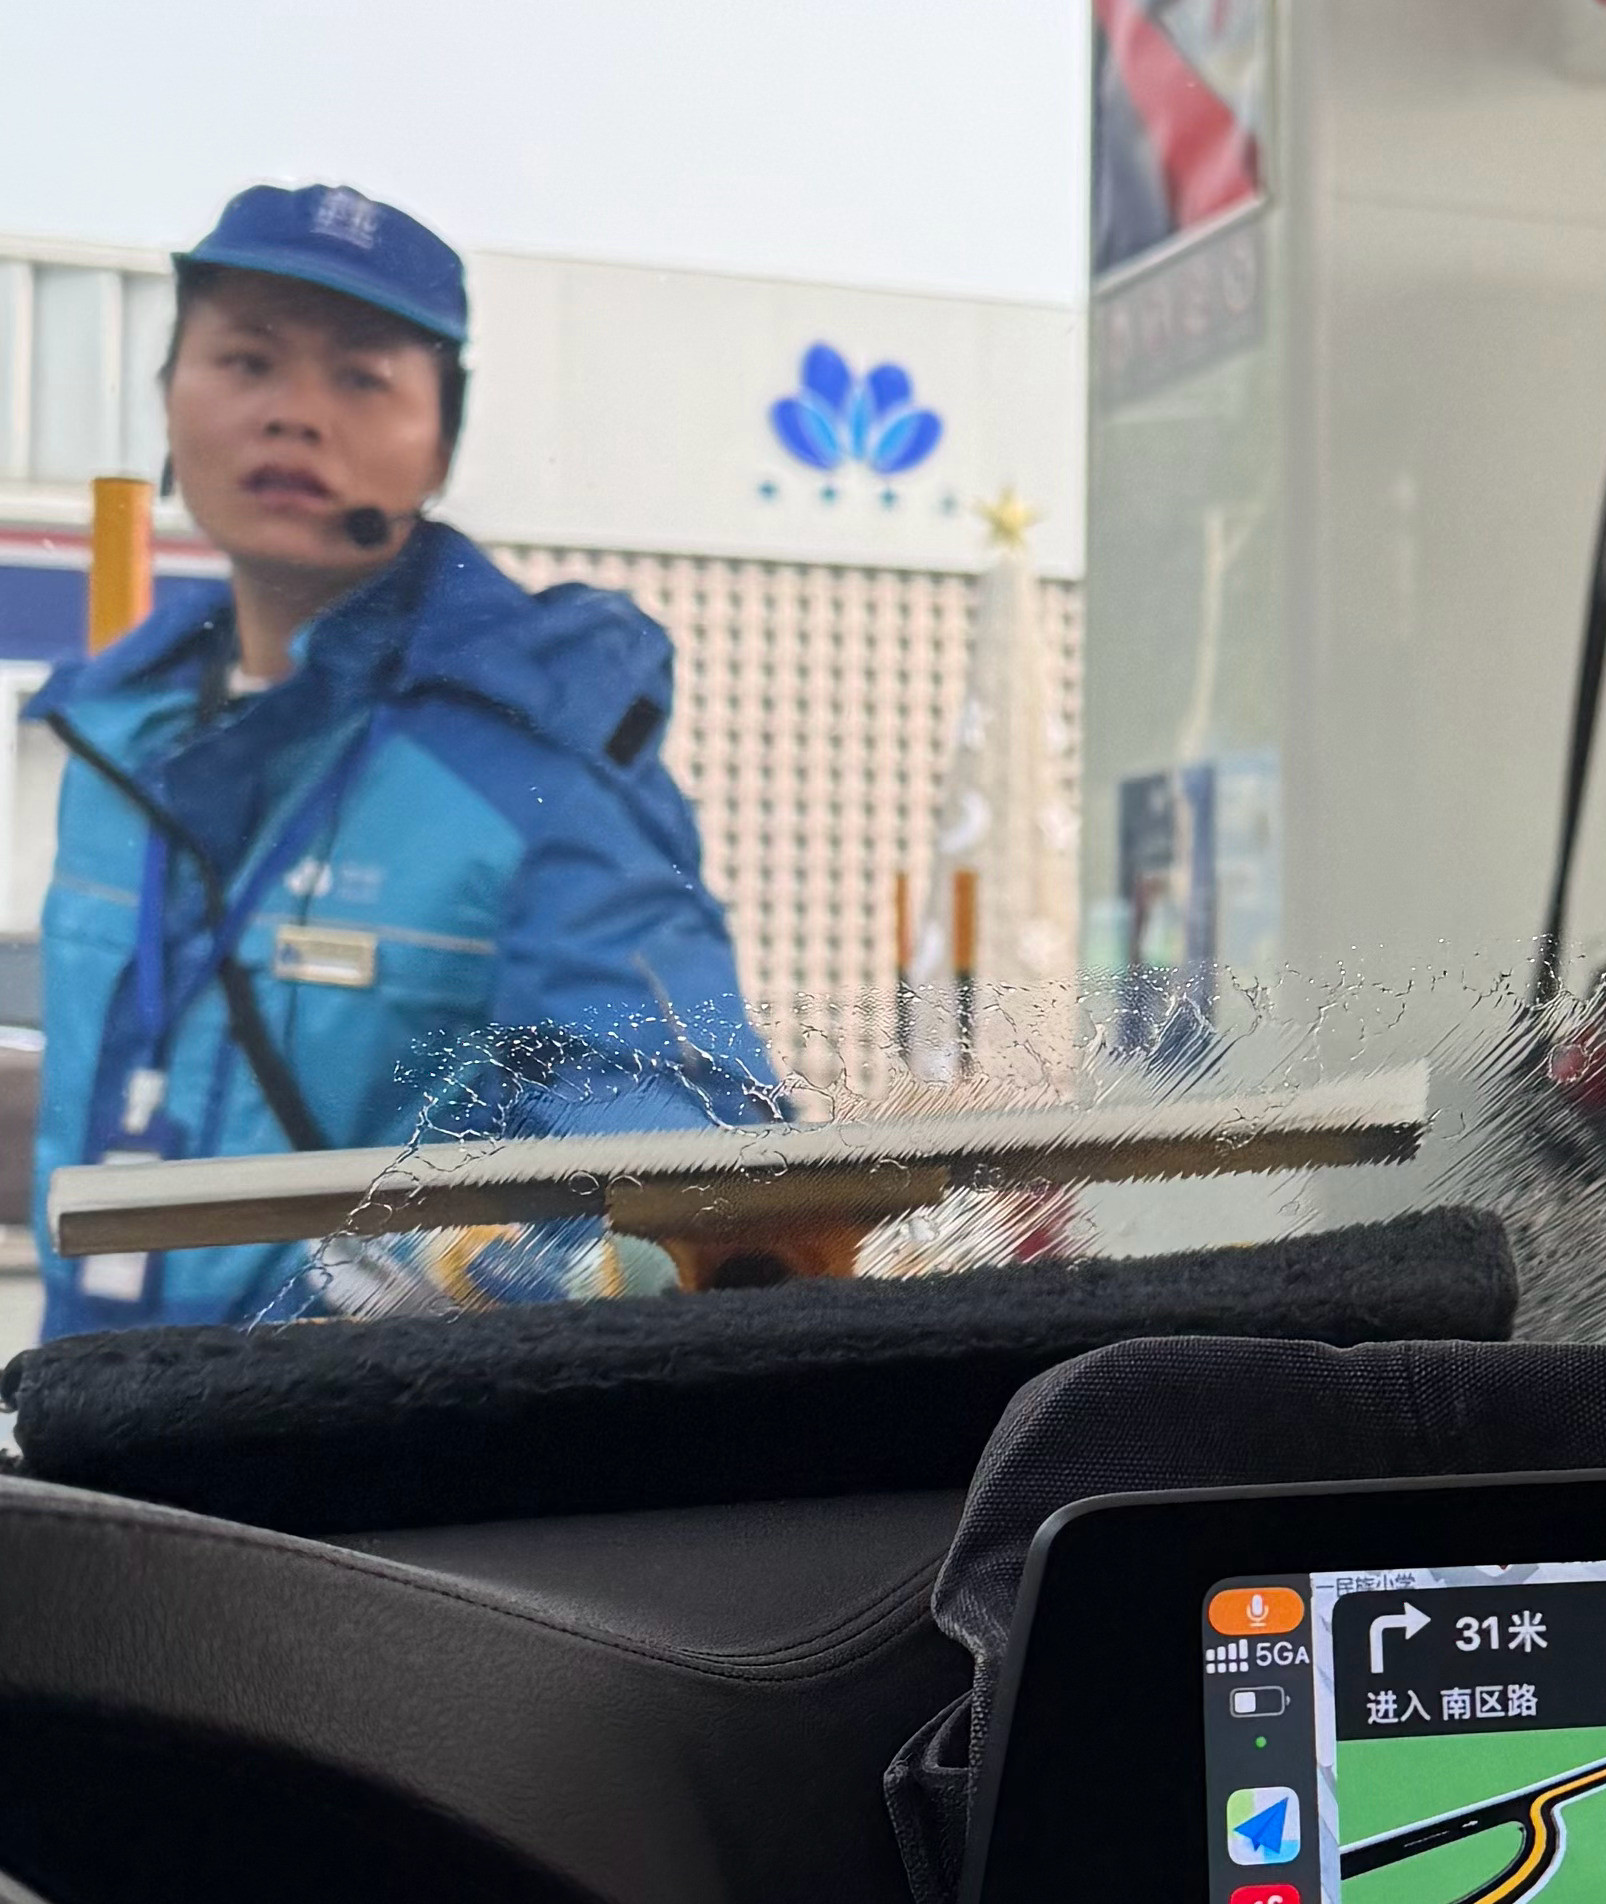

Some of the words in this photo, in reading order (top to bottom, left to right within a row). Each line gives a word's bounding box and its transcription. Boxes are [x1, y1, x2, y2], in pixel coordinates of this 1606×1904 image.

[1366, 1690, 1431, 1726] 进入
[1439, 1683, 1540, 1722] 南区路
